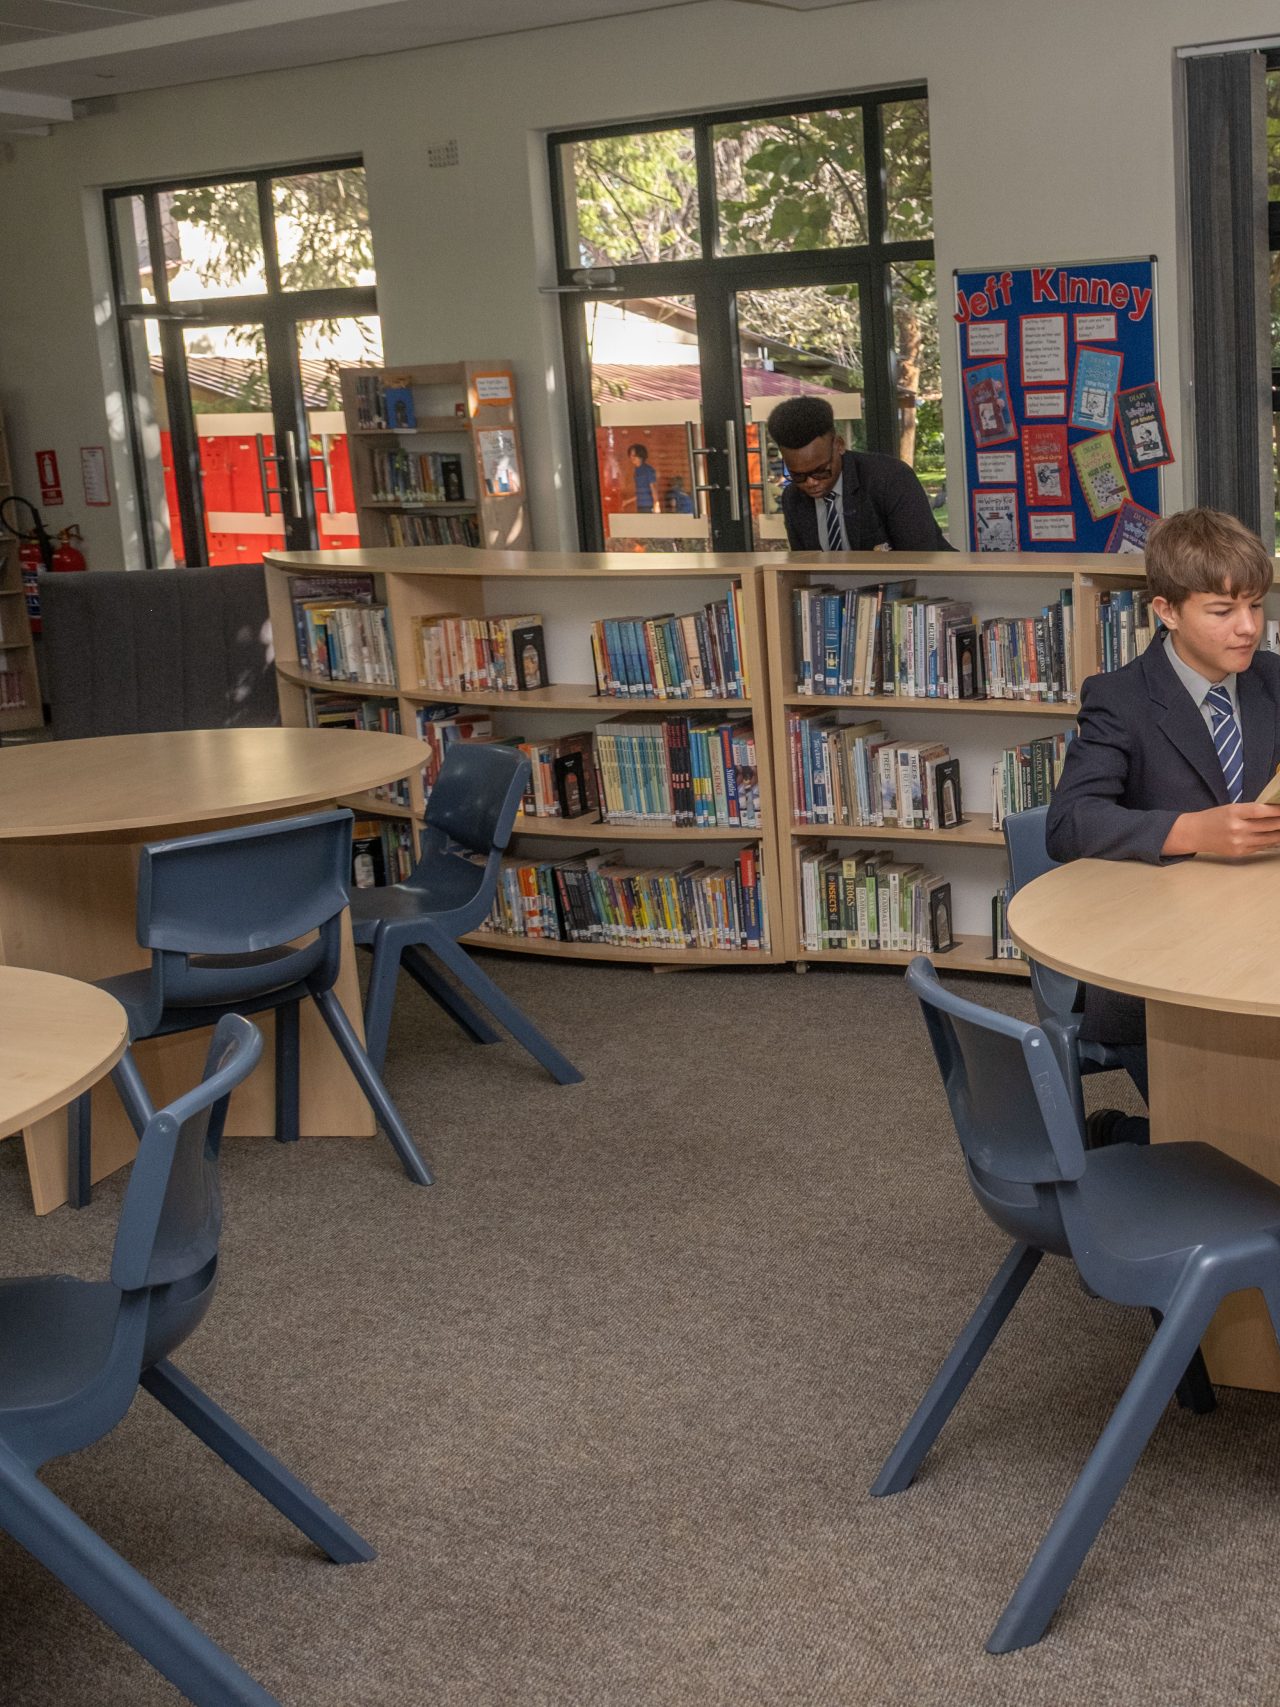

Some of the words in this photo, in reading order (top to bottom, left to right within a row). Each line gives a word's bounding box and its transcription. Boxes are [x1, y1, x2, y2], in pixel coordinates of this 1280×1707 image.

[953, 272, 1013, 323] Jeff
[1031, 267, 1152, 322] Kinney
[714, 765, 722, 796] SCIENCE
[883, 752, 891, 779] TREES
[726, 768, 735, 797] Statistics
[902, 768, 910, 794] TREES
[829, 882, 837, 913] INSECTS
[846, 880, 855, 907] FROGS
[881, 889, 889, 928] MAMMALS
